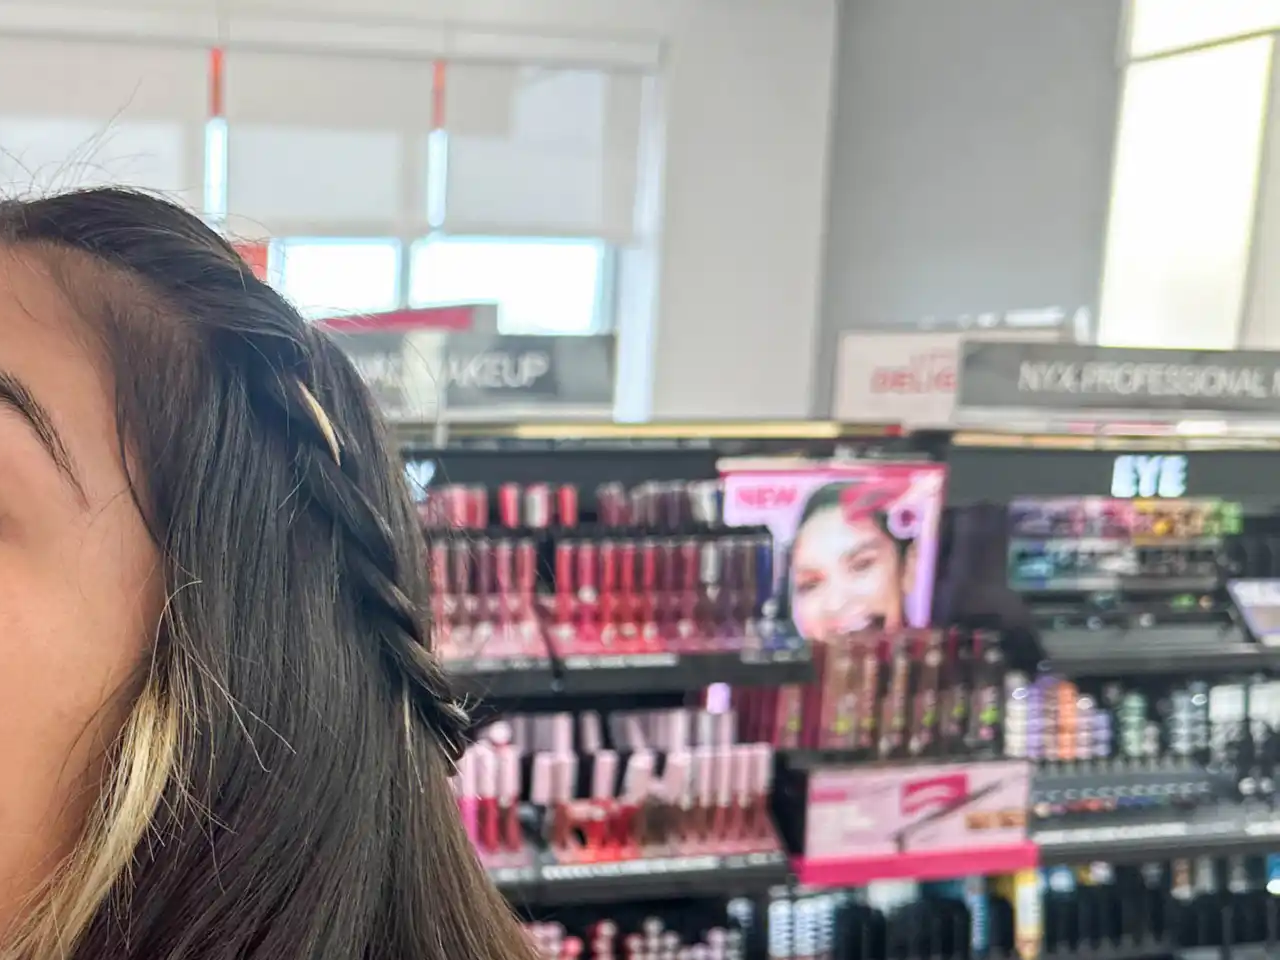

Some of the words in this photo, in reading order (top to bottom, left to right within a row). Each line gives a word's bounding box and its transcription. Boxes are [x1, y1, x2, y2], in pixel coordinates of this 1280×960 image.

[1081, 361, 1268, 398] PROFESSIONAL
[1110, 454, 1188, 498] EYE
[736, 486, 798, 509] NEW
